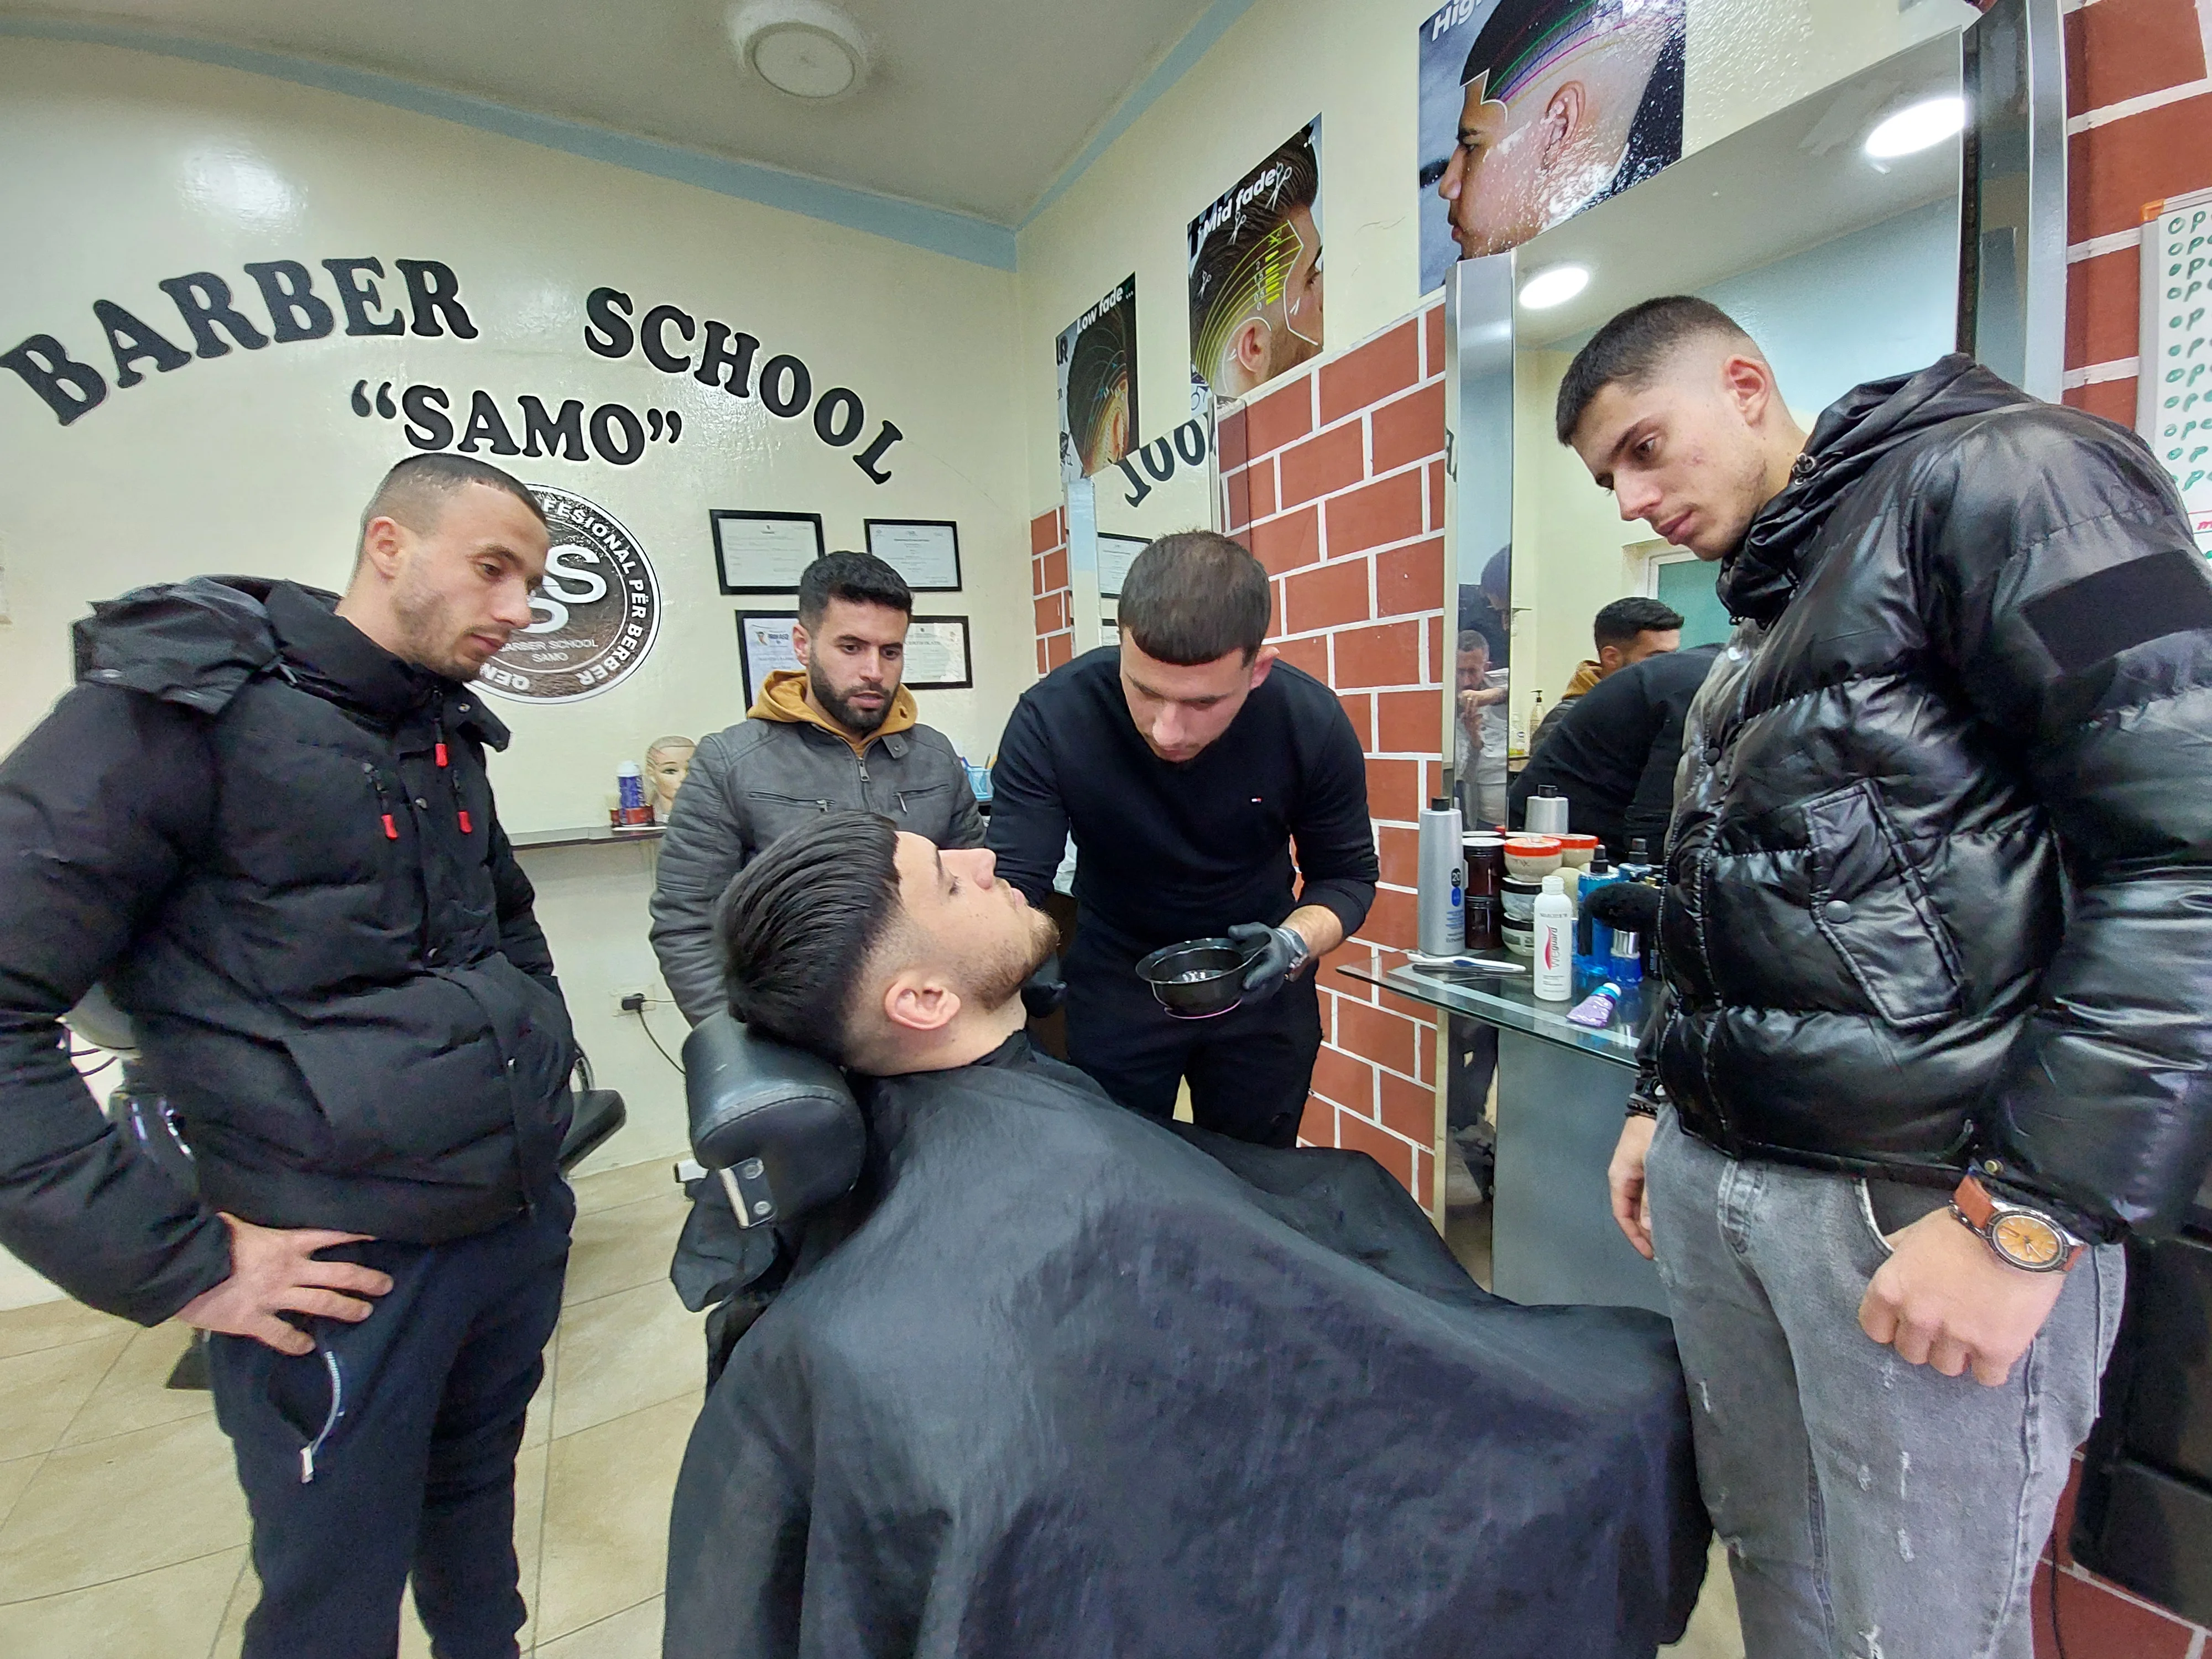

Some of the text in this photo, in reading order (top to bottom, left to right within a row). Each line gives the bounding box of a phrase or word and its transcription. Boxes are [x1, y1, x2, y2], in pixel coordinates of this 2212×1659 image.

[1432, 0, 1482, 41] Hig
[1203, 198, 1232, 237] Mid
[1236, 169, 1276, 210] fade
[1077, 306, 1097, 335] Low
[1099, 287, 1123, 317] fade
[0, 257, 903, 484] BARBER SCHOOL
[479, 498, 649, 690] QEN FESIONAL PËR BERBER
[499, 639, 598, 652] ARBER SCHOOL
[531, 652, 569, 662] SAMO
